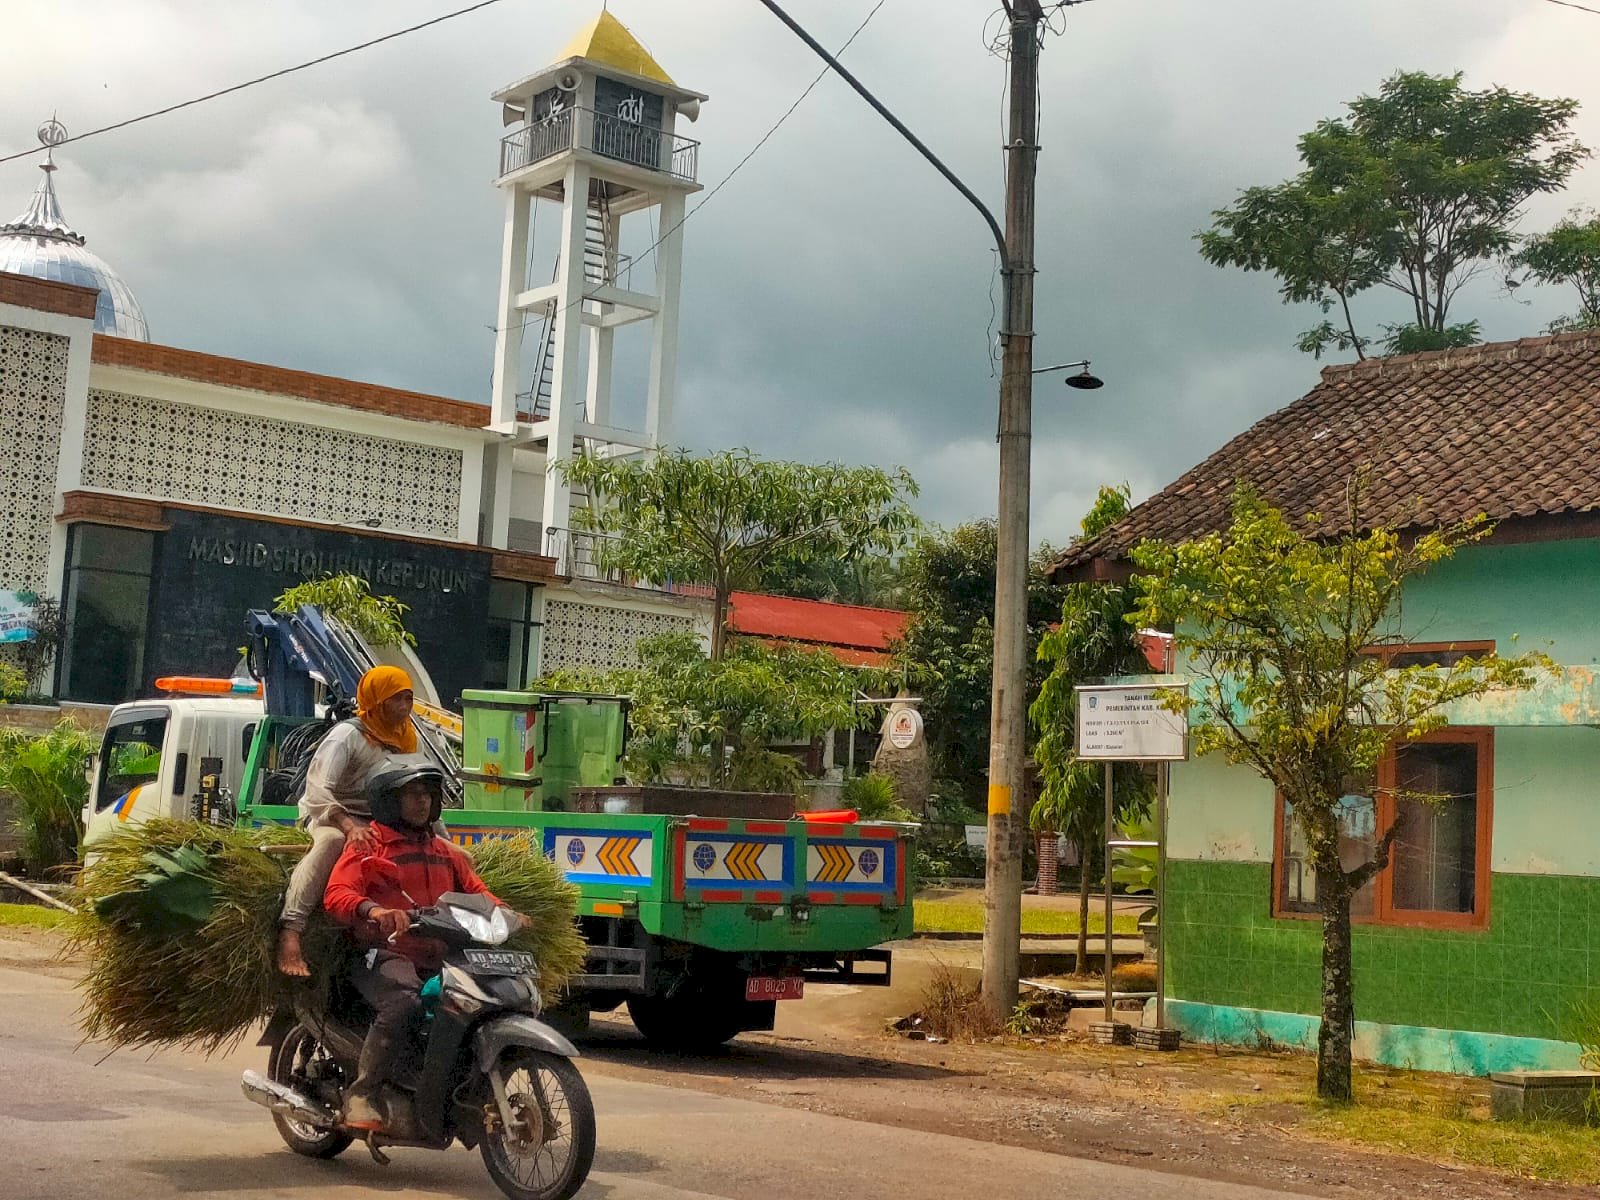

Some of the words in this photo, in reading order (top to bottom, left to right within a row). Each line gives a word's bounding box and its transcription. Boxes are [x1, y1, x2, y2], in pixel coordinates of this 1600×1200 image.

[187, 536, 268, 568] MASJID
[748, 980, 759, 993] AD
[765, 980, 786, 993] 8025
